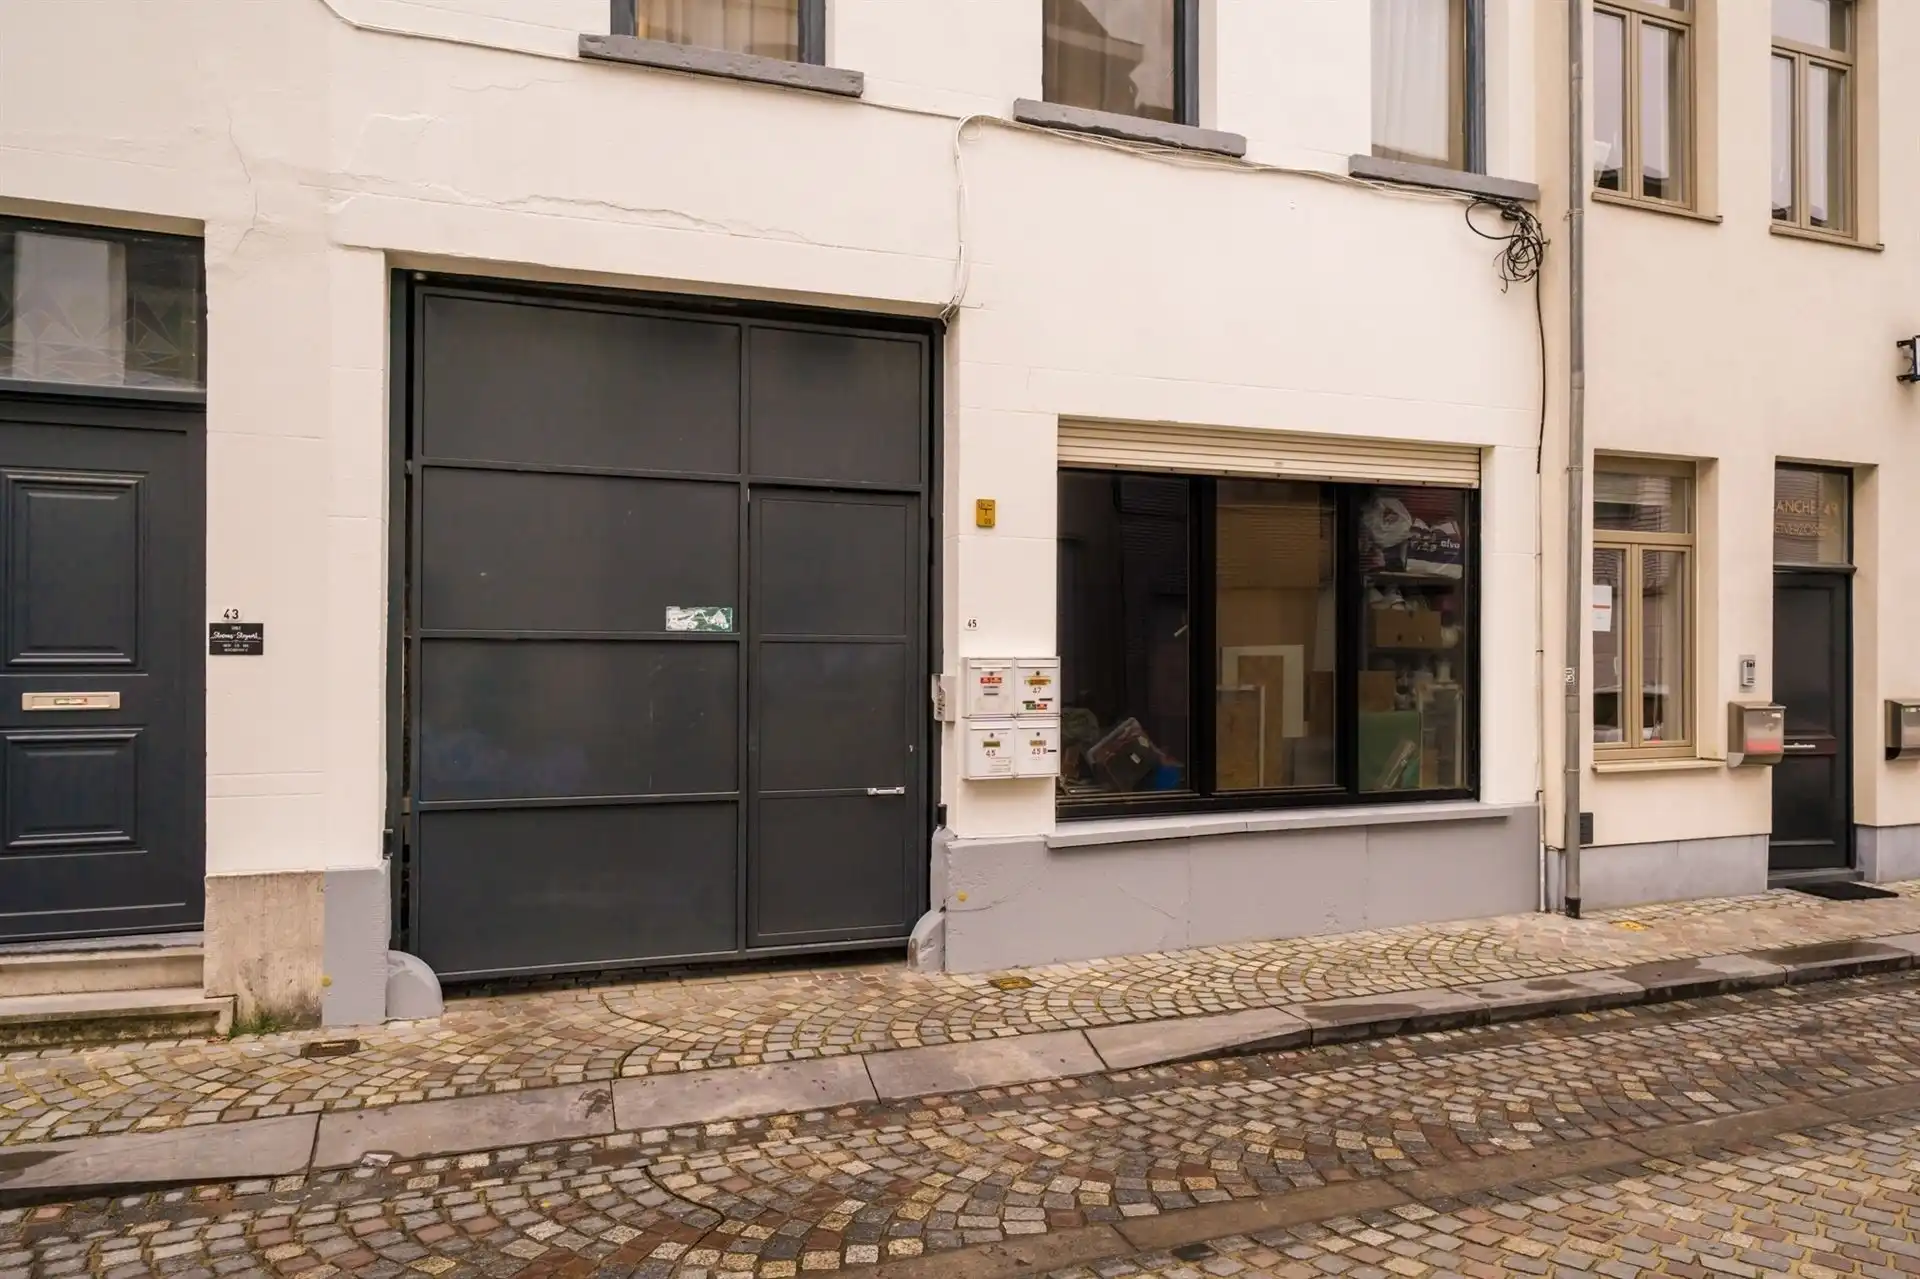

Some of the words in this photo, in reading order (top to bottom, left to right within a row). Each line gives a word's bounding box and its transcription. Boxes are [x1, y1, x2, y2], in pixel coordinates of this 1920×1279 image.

[223, 608, 239, 620] 43
[967, 618, 977, 628] 45
[985, 749, 996, 757] 45
